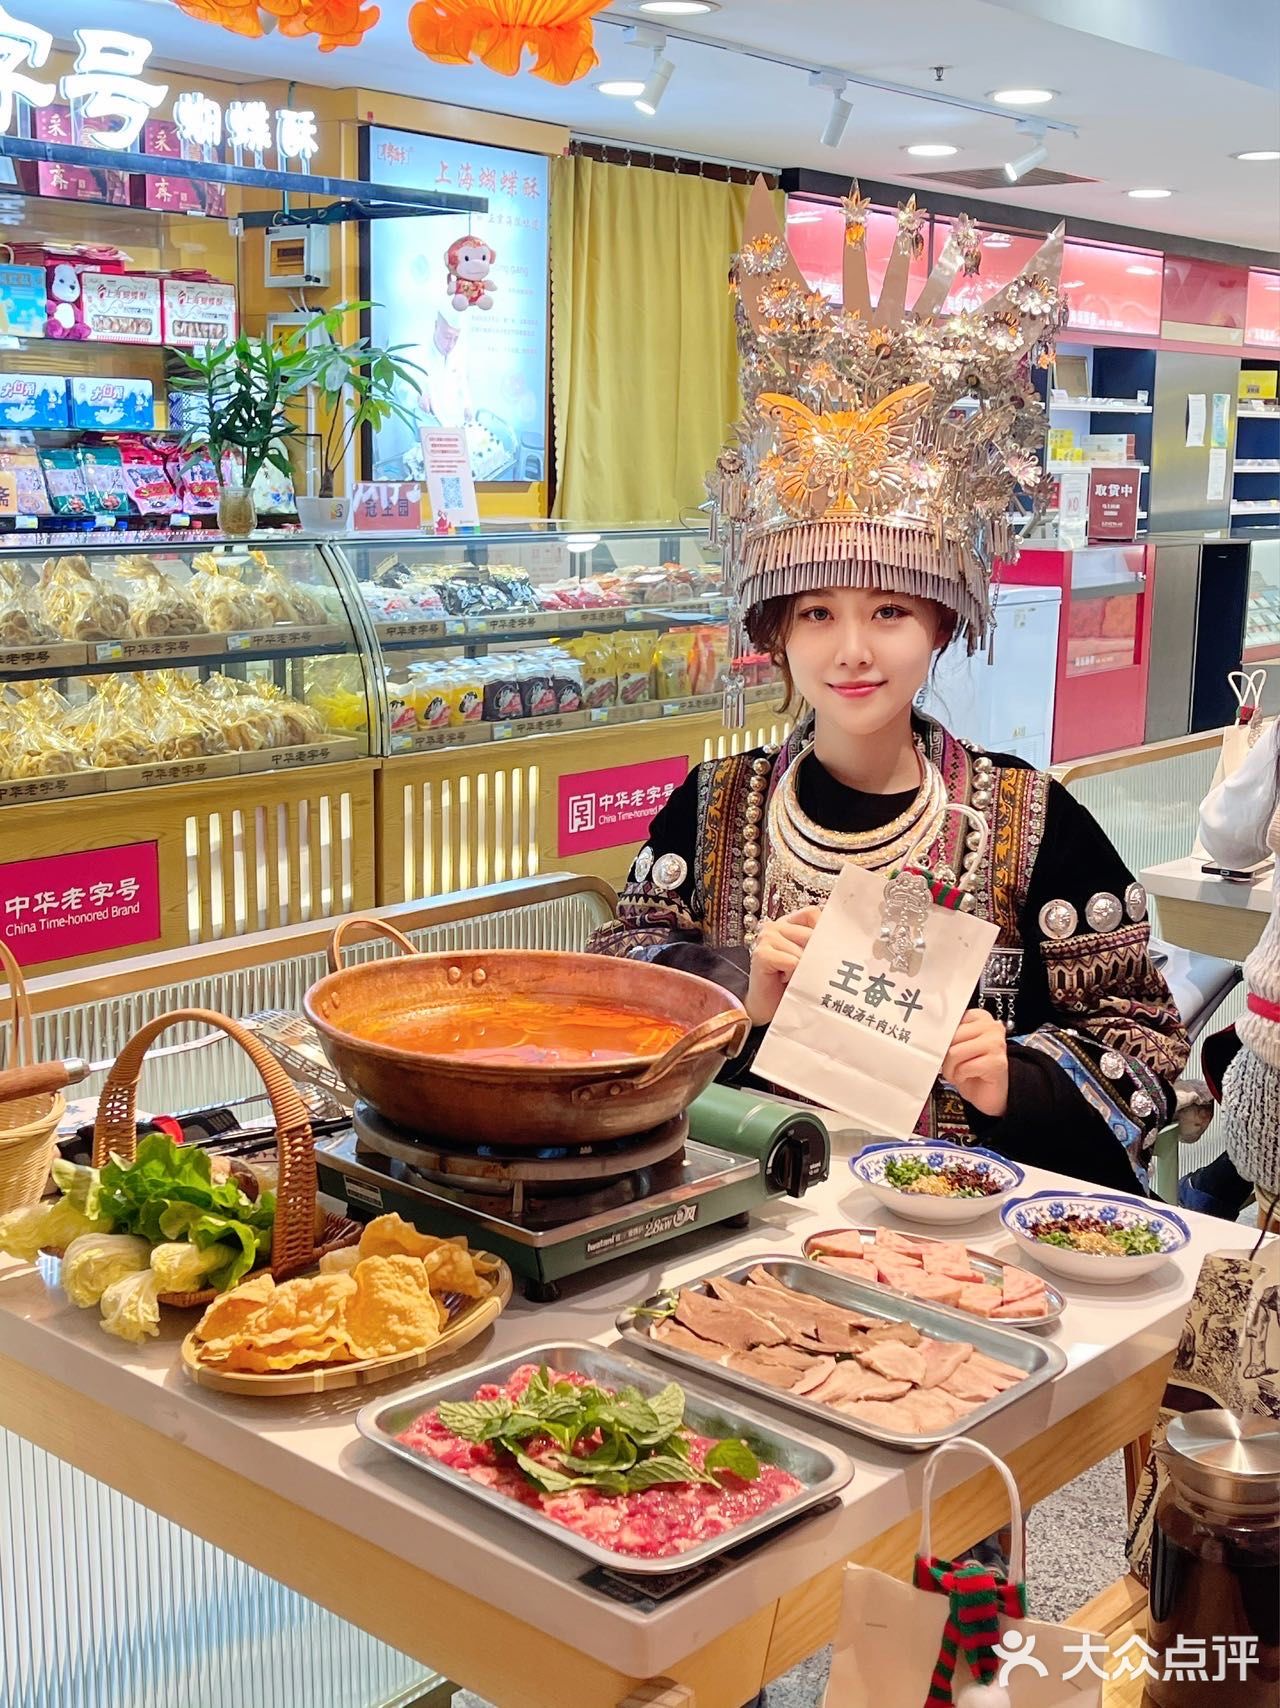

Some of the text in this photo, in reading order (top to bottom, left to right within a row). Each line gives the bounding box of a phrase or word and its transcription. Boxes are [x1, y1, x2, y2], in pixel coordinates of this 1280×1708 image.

[435, 160, 540, 199] 上海蝴蝶酥
[124, 641, 190, 657] 中华老字号
[253, 631, 312, 645] 中华老字号
[272, 748, 330, 765] 中华老字号
[142, 763, 207, 782] 中华老字号
[5, 877, 140, 920] 中华老字号
[5, 901, 140, 937] China Time-honored Brand
[829, 960, 923, 1023] 王奋斗
